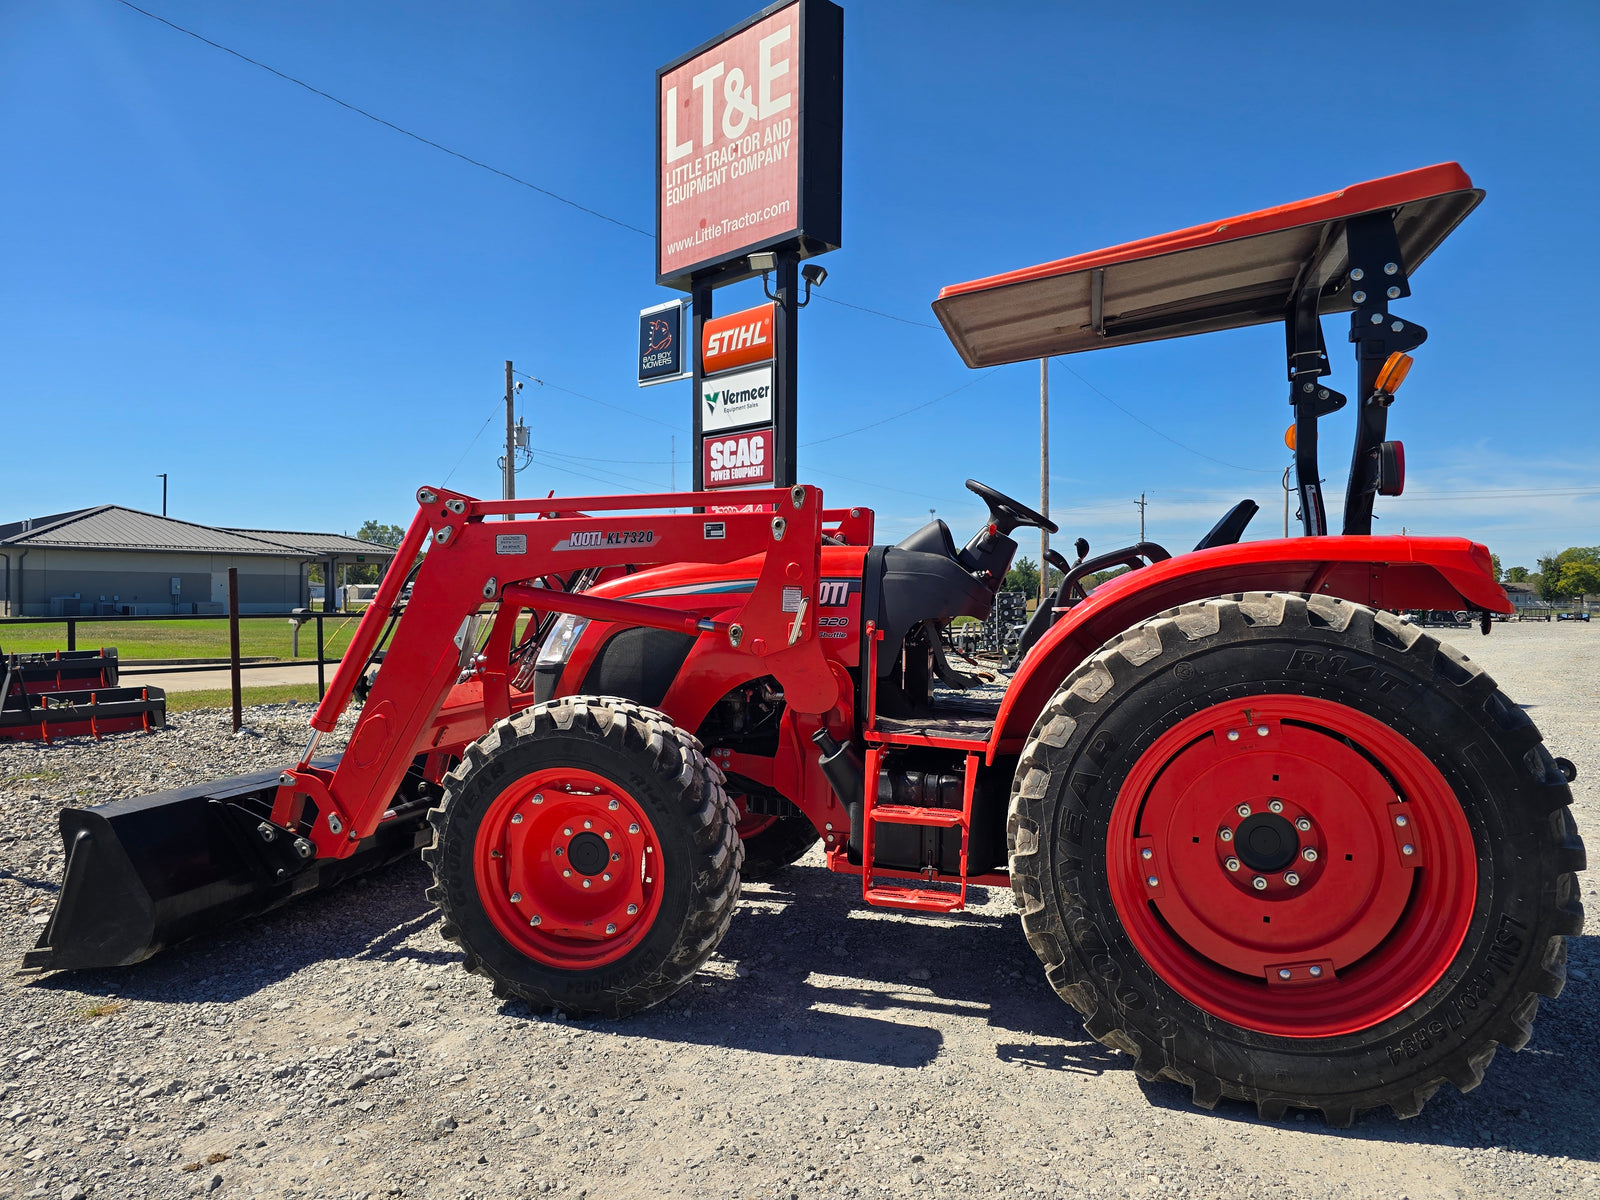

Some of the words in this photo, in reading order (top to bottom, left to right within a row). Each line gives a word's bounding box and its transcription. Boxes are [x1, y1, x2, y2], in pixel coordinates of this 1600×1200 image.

[666, 24, 791, 164] LT&E
[666, 158, 702, 189] LITTLE
[704, 134, 760, 173] TRACTOR
[763, 118, 791, 149] AND
[666, 166, 728, 207] EQUIPMENT
[731, 139, 790, 179] COMPANY
[667, 199, 790, 255] www.LittleTractor.com
[706, 321, 767, 357] STIHL
[643, 354, 656, 363] BAD
[657, 351, 672, 360] BOY
[643, 357, 672, 370] MOWERS
[722, 385, 769, 405] Vermeer
[723, 404, 746, 414] Equipment
[710, 436, 764, 470] SCAG
[711, 469, 731, 482] POWER
[731, 465, 764, 479] EQUIPMENT
[569, 531, 602, 547] KIOTI
[607, 530, 653, 545] KL7320
[819, 582, 849, 605] OTI
[818, 617, 849, 627] 320
[1057, 729, 1181, 1040] GOODYEAR
[1485, 912, 1528, 975] LSW
